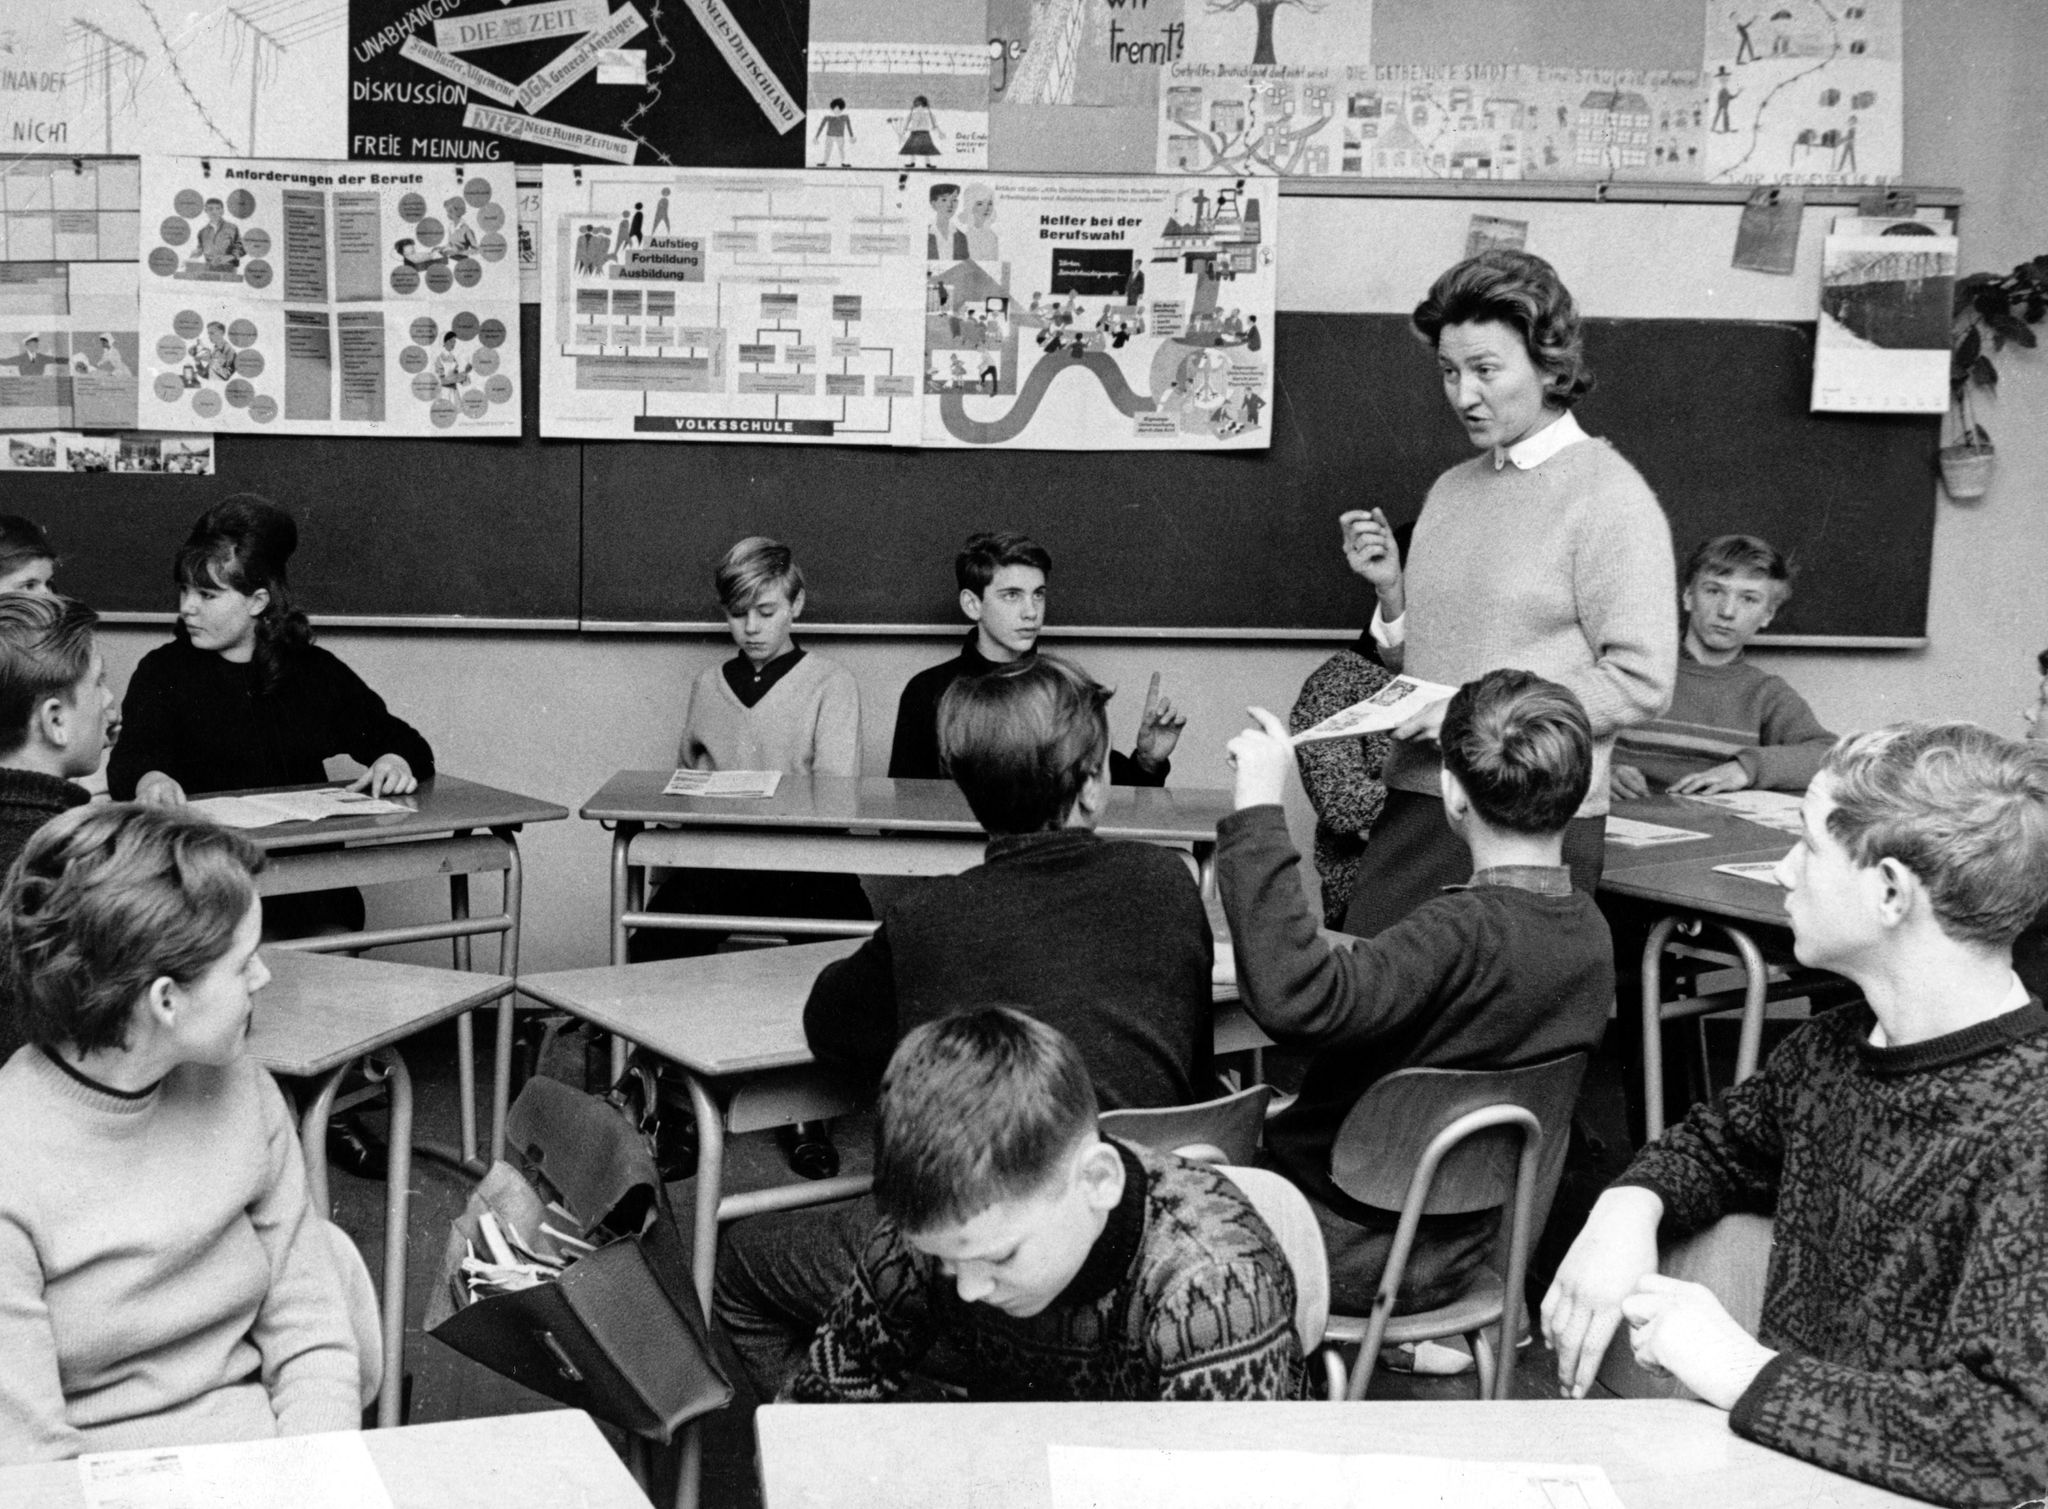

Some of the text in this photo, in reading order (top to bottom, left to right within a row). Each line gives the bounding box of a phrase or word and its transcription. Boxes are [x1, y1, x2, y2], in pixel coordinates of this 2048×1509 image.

[459, 7, 577, 44] DIE ZEIT
[549, 14, 635, 84] General-Anzeiger
[1109, 18, 1185, 66] trennt?
[462, 62, 515, 98] Allgemeine
[727, 33, 794, 122] DEUTSCHLAND
[411, 138, 500, 161] MEINUNG
[225, 168, 424, 186] Anforderungen der Berufe
[1040, 214, 1143, 228] Helfer bei der
[1039, 228, 1125, 241] Berufswahl
[649, 238, 700, 251] Aufstieg
[631, 253, 699, 267] Fortbildung
[618, 268, 685, 281] Ausbildung
[674, 418, 795, 432] VOLKSSCHULE
